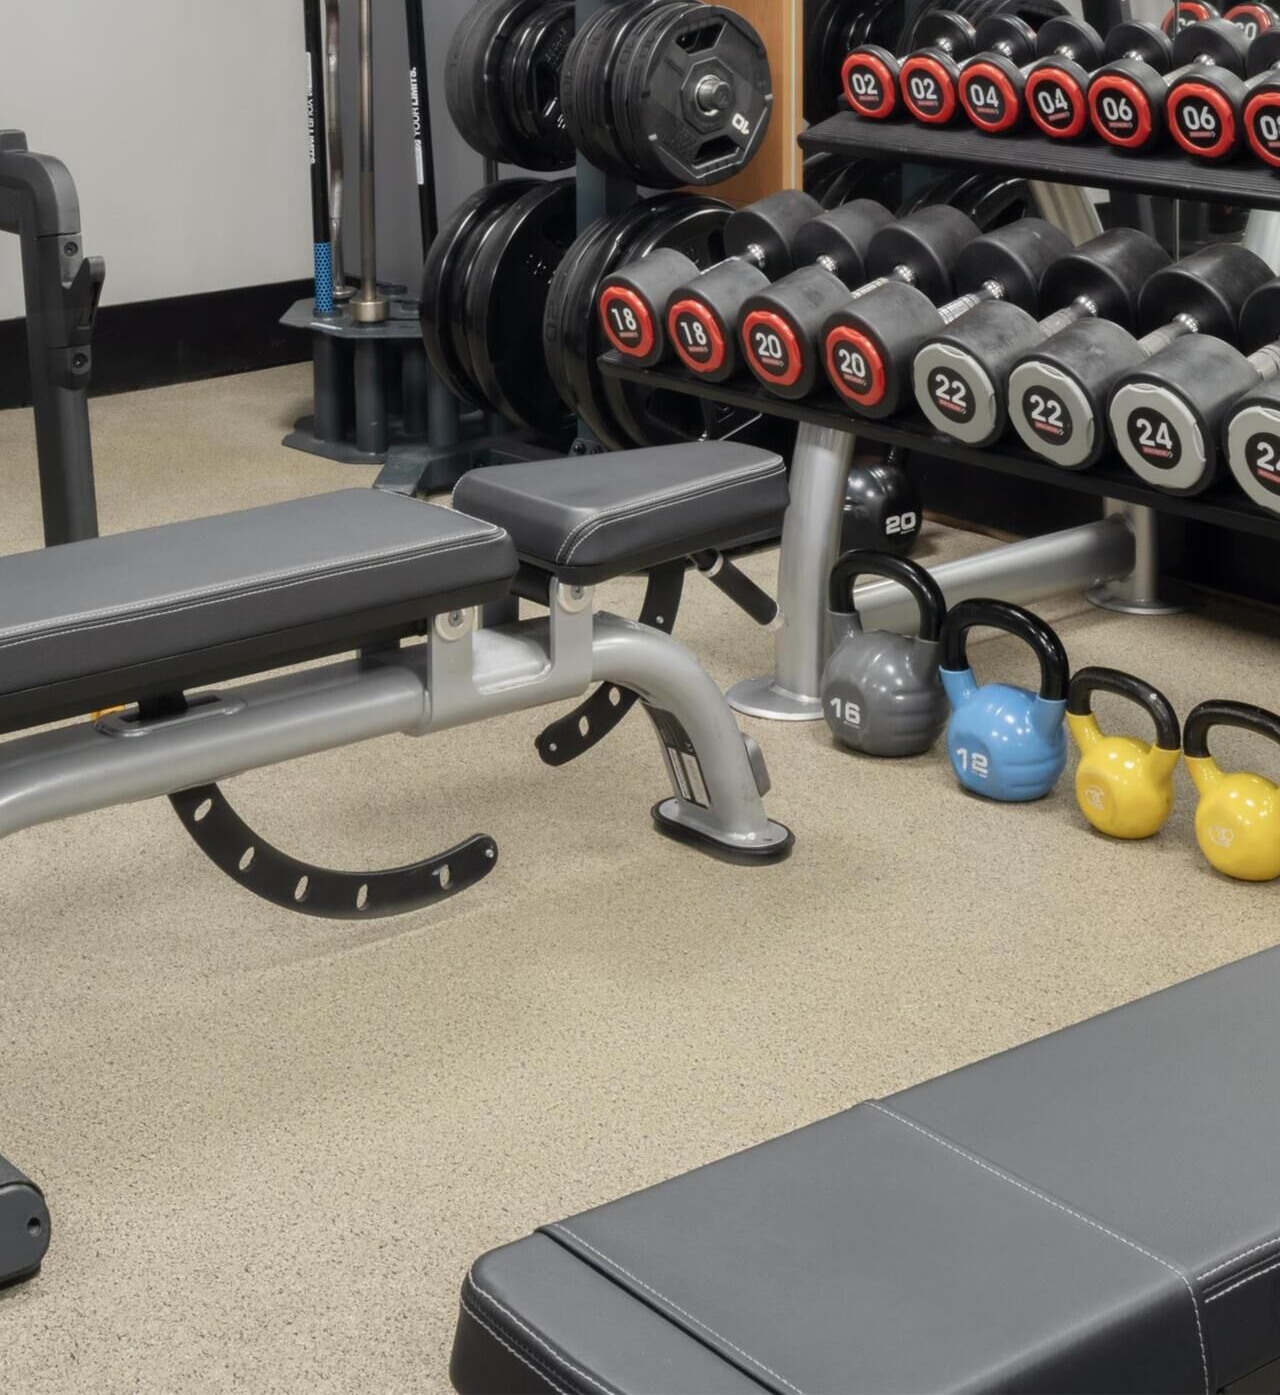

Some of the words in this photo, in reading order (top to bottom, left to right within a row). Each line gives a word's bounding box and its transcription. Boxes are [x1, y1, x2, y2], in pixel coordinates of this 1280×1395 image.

[851, 73, 878, 95] 02
[910, 77, 938, 100] 02
[970, 84, 1000, 108] 04
[1037, 88, 1068, 114] 04
[1102, 97, 1133, 121] 06
[412, 108, 421, 137] YOUR
[731, 112, 750, 135] 10
[1182, 105, 1216, 130] 06
[611, 307, 637, 331] 18
[680, 321, 707, 346] 18
[755, 332, 783, 359] 20
[838, 348, 866, 378] 20
[934, 373, 968, 408] 22
[1029, 394, 1065, 428] 22
[1135, 418, 1173, 450] 24
[886, 511, 916, 535] 20
[830, 697, 861, 725] 16
[956, 747, 988, 774] 12
